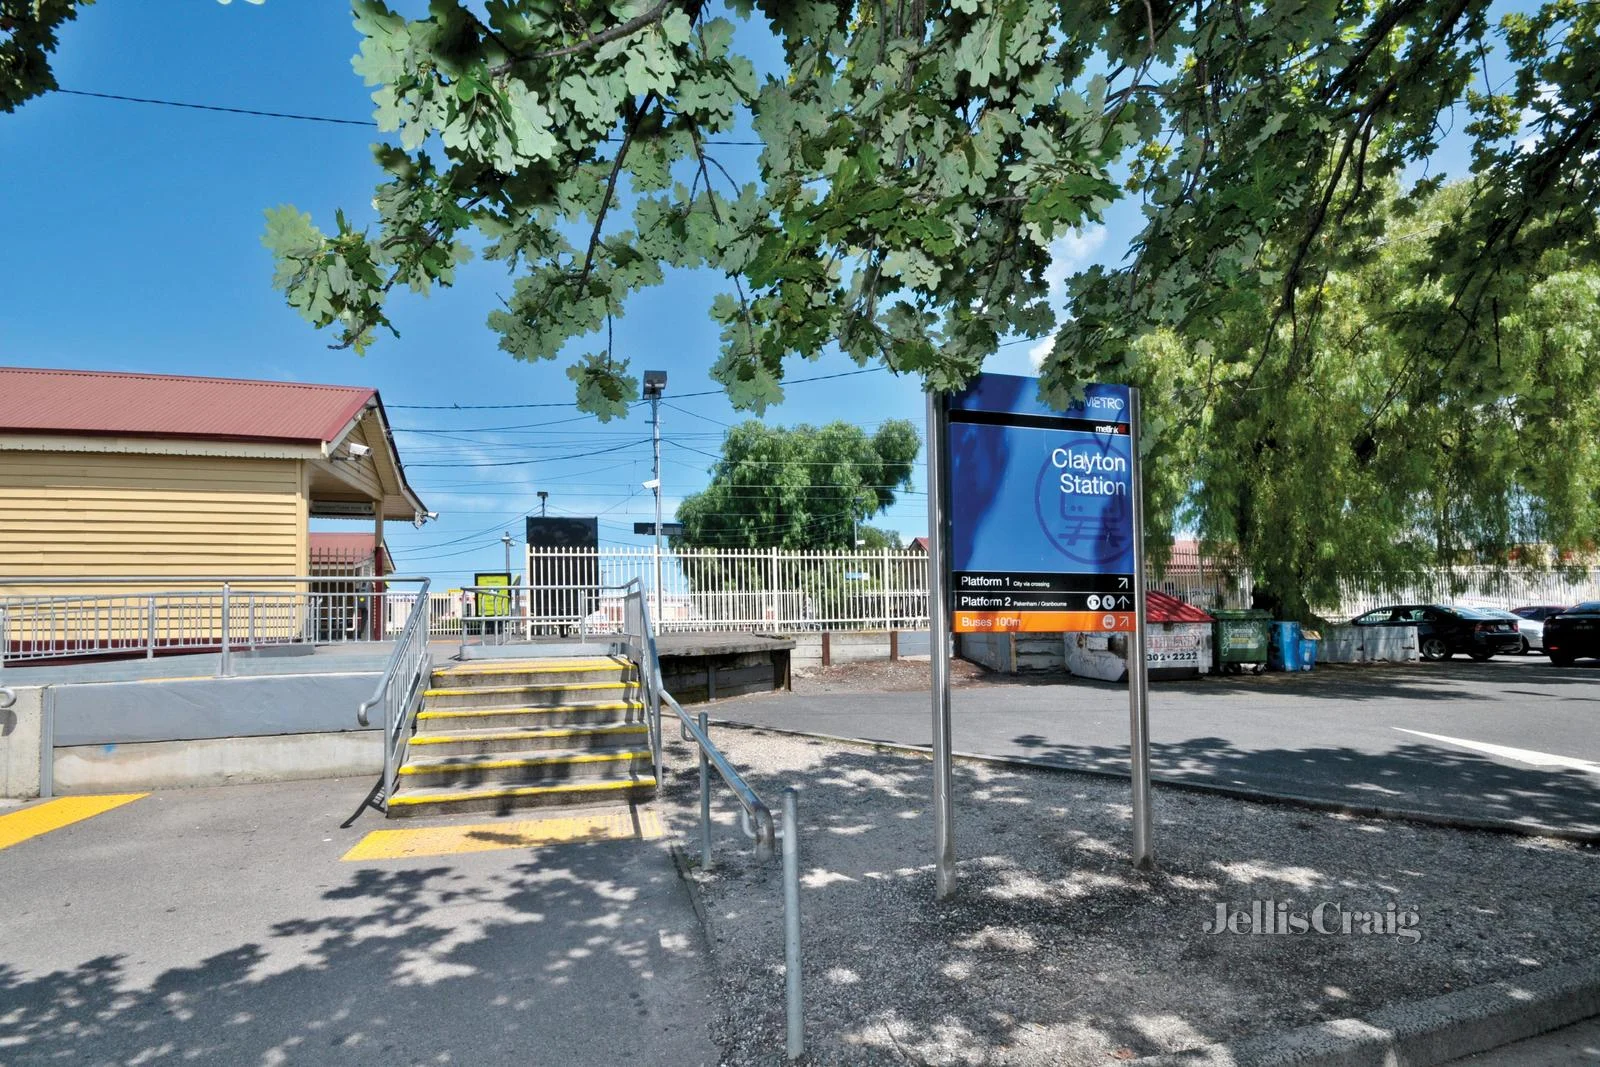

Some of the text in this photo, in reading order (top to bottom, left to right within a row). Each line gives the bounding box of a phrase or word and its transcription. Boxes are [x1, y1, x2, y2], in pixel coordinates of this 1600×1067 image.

[1052, 448, 1126, 474] Clayton
[1060, 474, 1126, 496] Station
[961, 576, 1002, 587] Platform
[1005, 576, 1010, 587] 1
[1013, 580, 1022, 588] City
[961, 597, 1002, 607] Platform
[1004, 597, 1011, 607] 2
[961, 616, 1021, 627] Buses 100m
